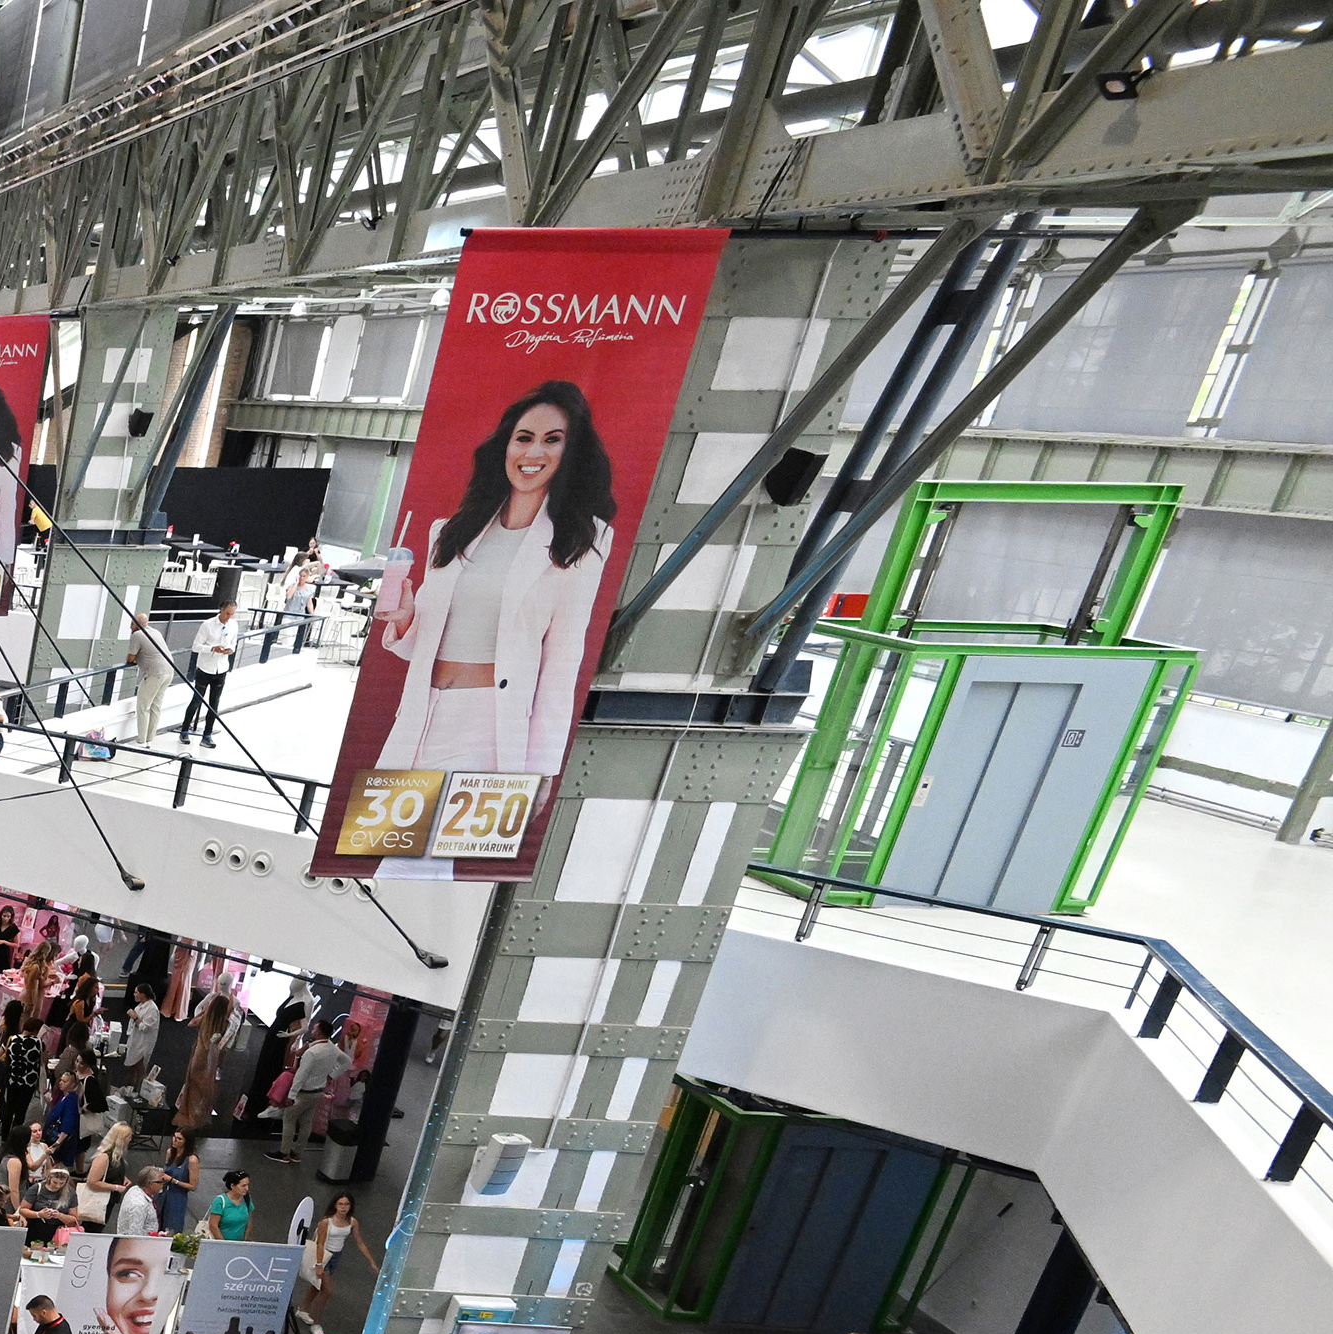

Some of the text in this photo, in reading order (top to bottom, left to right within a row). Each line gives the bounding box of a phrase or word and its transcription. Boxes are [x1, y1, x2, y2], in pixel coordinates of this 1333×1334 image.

[466, 292, 687, 325] ROSSMANN
[366, 776, 430, 788] ROSSMANN
[460, 777, 530, 790] MÁR TÖBB MINT
[355, 790, 425, 829] 30
[442, 791, 529, 839] 250
[351, 825, 415, 849] éves
[437, 841, 516, 853] BOLTBAN VÁRUNK
[223, 1282, 283, 1294] szérumok
